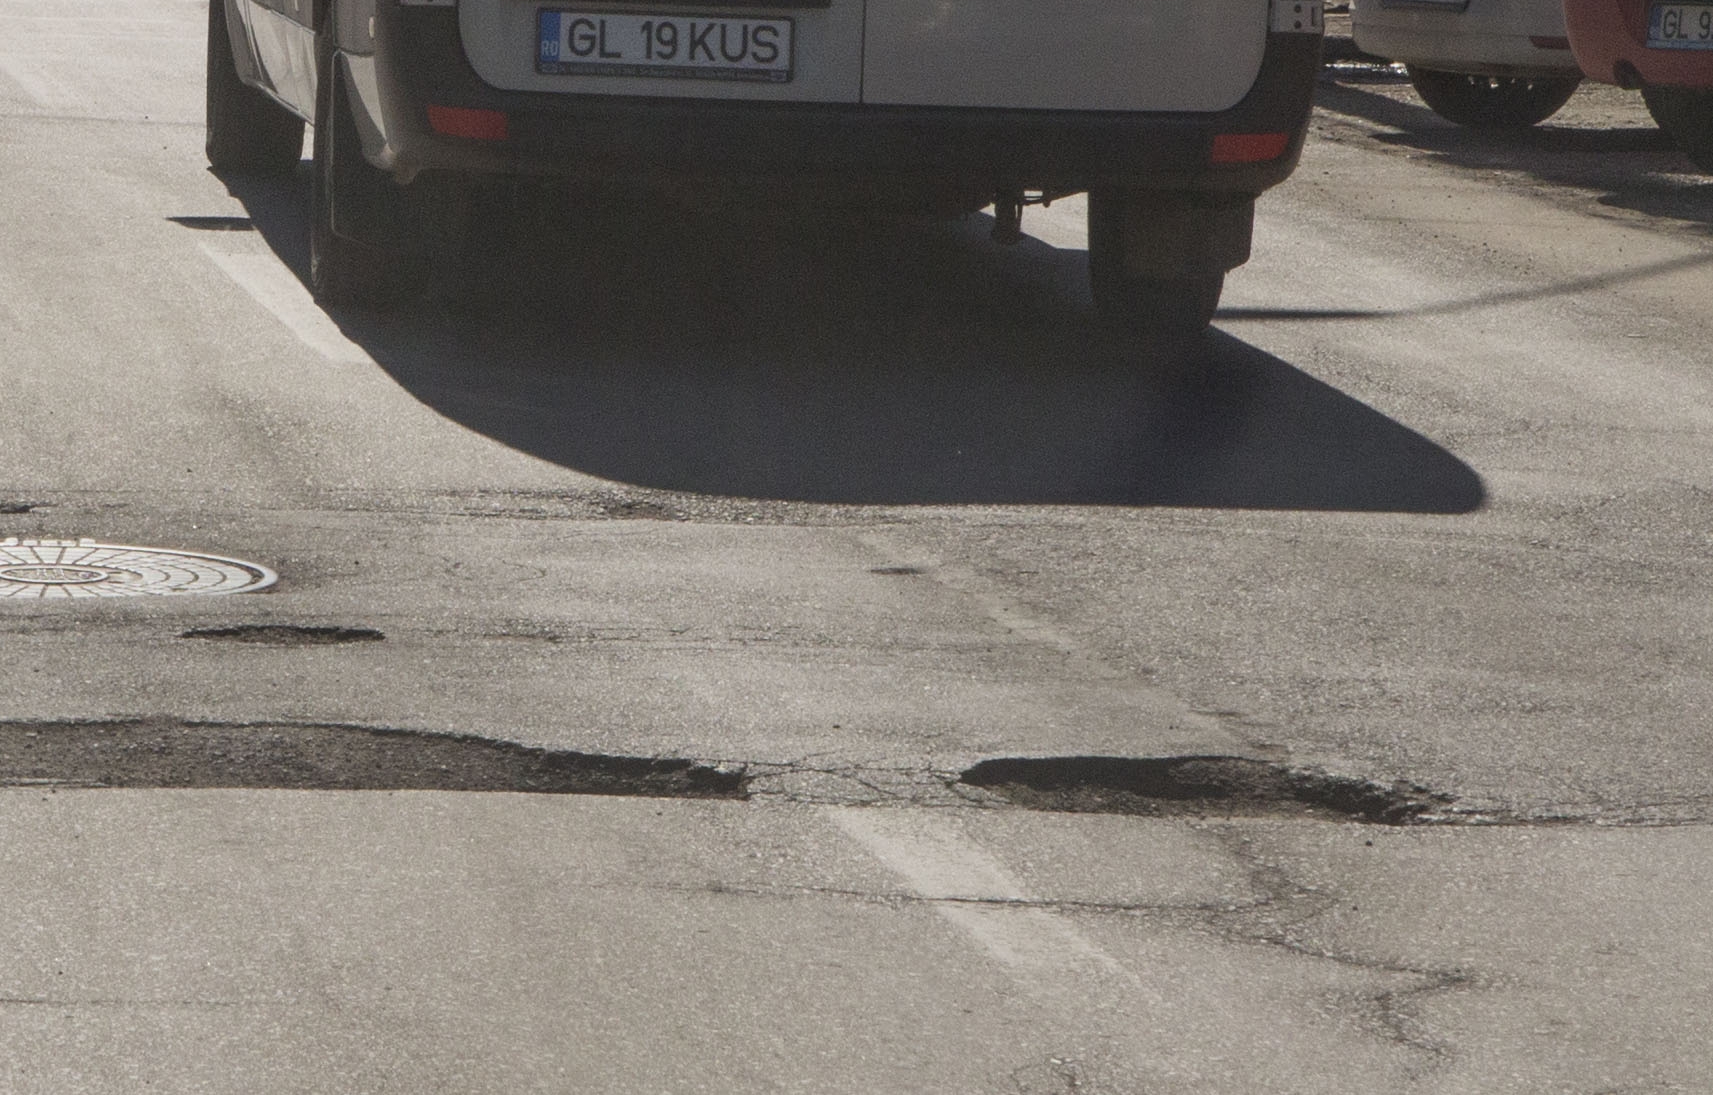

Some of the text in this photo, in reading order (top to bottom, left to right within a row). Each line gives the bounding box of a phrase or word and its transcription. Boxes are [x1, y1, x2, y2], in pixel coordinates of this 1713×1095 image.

[1663, 9, 1688, 39] GL
[541, 40, 558, 56] RO
[568, 17, 780, 63] GL 19 KUS
